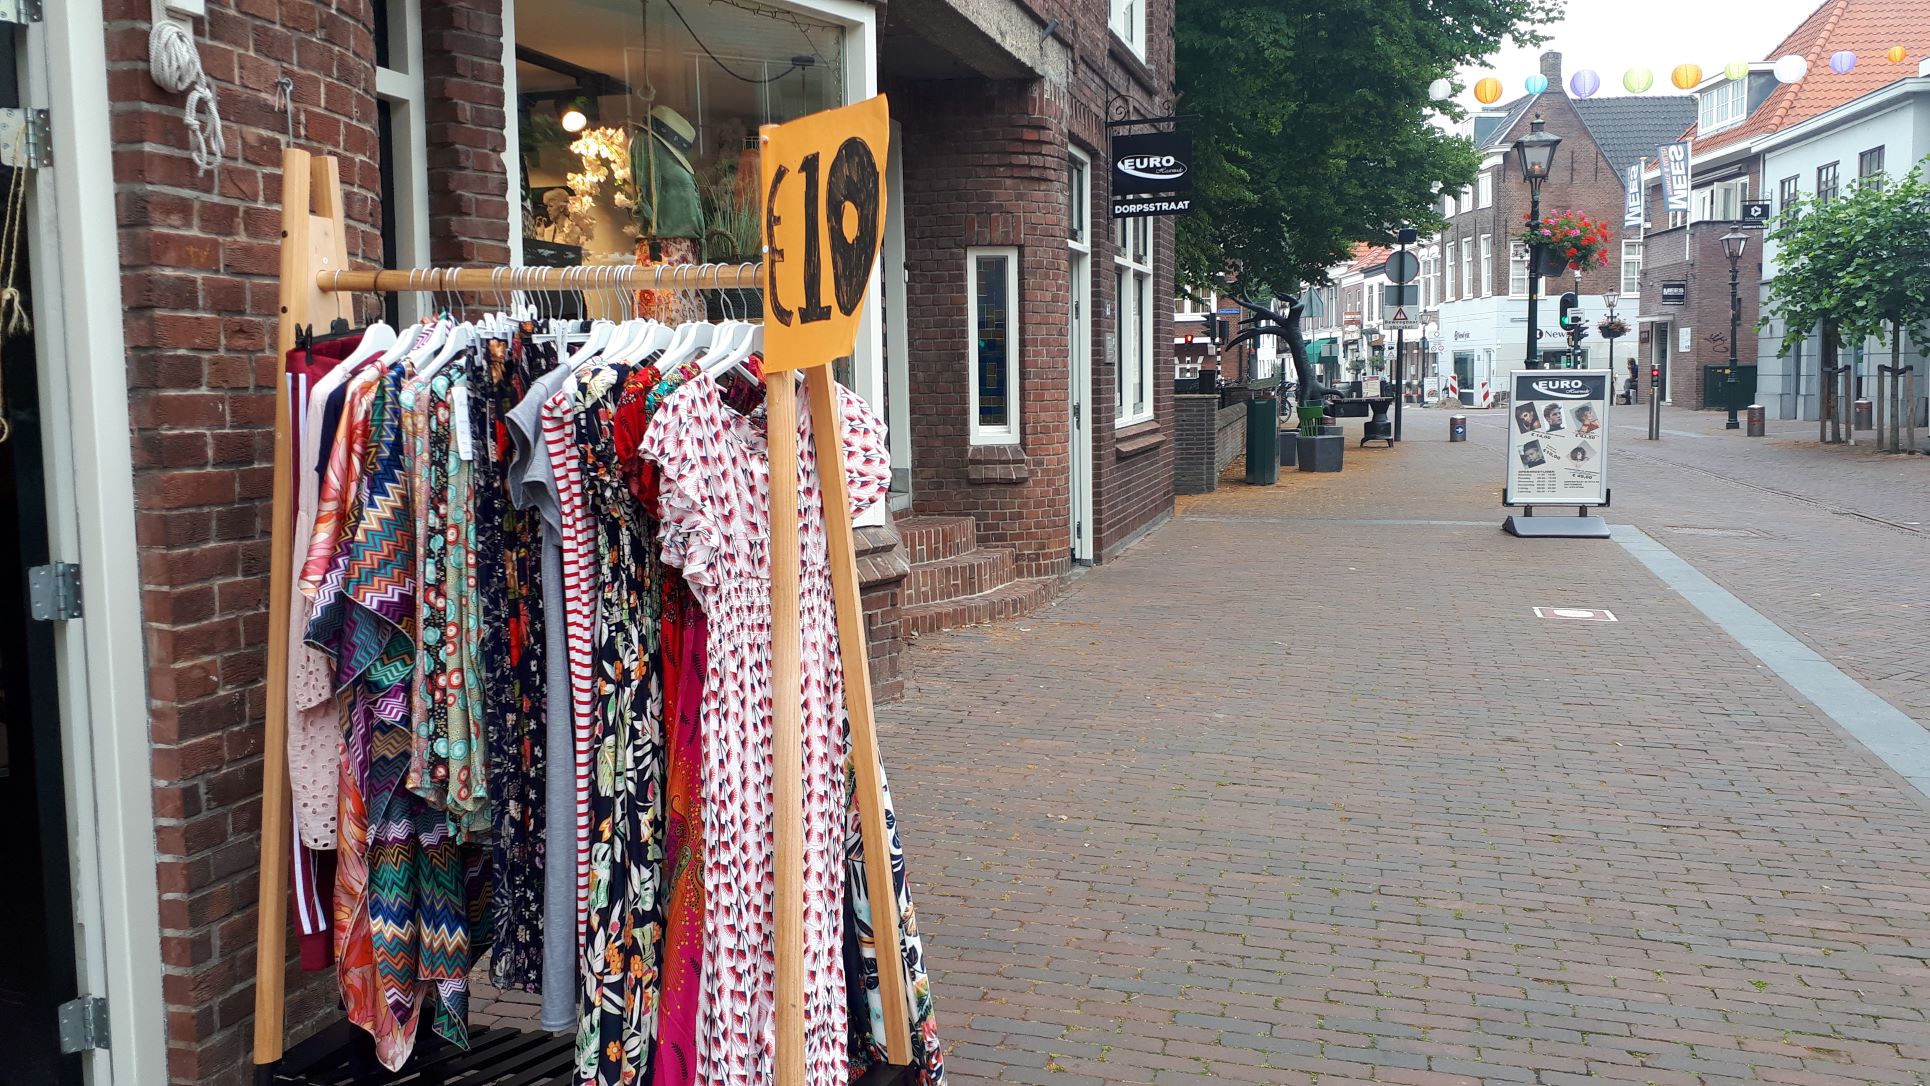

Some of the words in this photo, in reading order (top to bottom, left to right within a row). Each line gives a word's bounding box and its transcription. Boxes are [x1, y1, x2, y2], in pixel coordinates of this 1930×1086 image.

[1124, 156, 1175, 170] EURO
[1114, 200, 1190, 214] DORPSSTRAAT
[767, 137, 880, 328] €10
[1663, 287, 1684, 295] MEES
[1538, 380, 1583, 389] EURO
